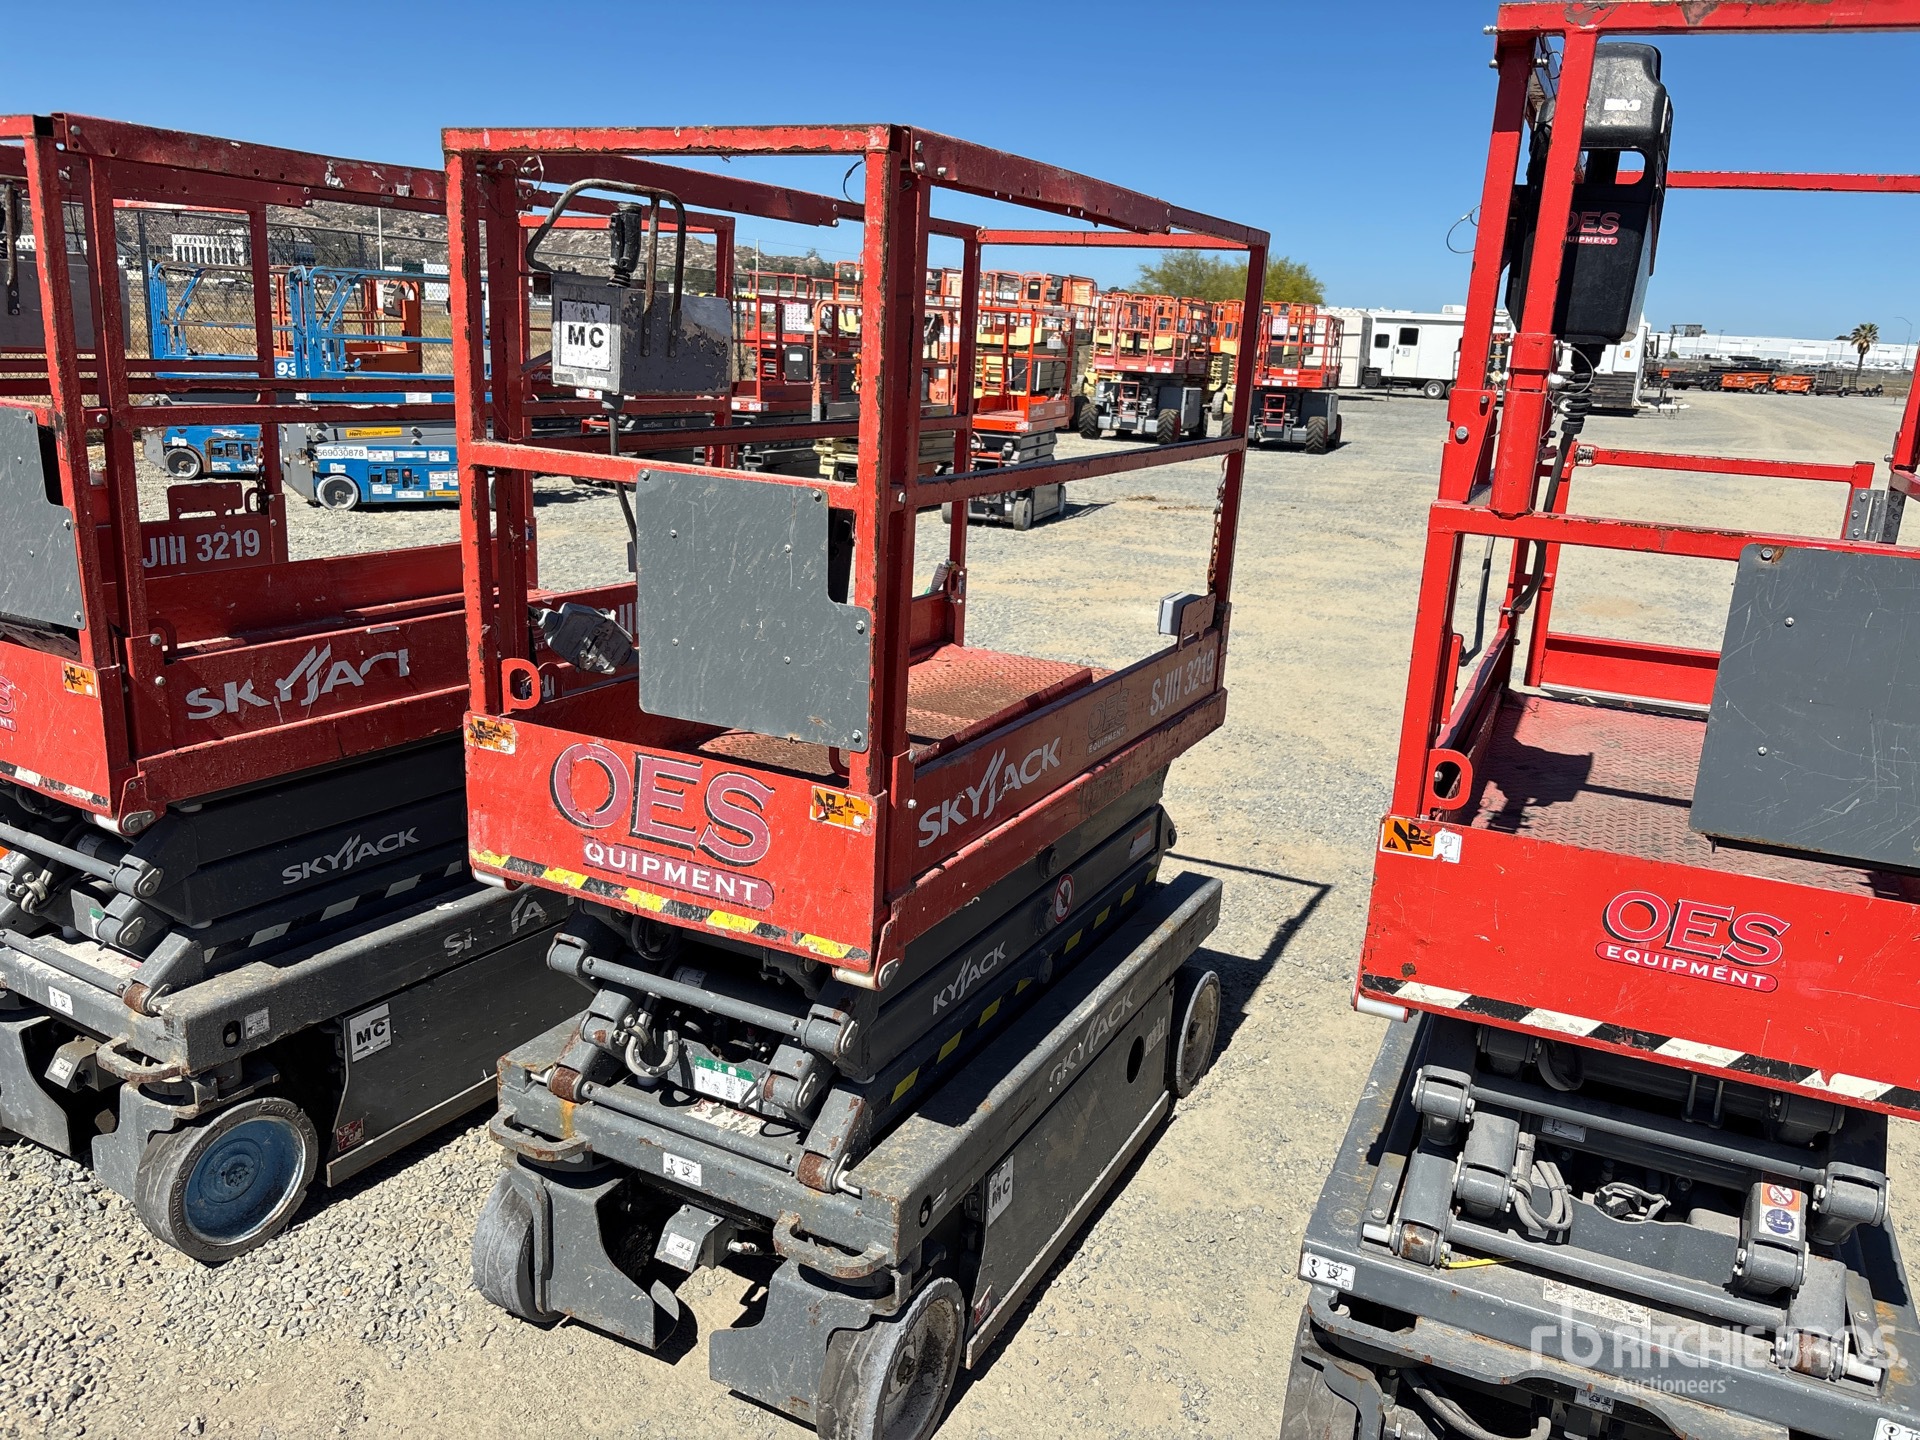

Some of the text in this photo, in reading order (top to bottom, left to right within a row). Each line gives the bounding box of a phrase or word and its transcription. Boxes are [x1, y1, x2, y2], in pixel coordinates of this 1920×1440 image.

[1566, 236, 1615, 244] UIPMENT
[567, 325, 605, 348] MC
[317, 449, 365, 457] 569030878
[196, 529, 260, 562] 3219
[1184, 648, 1215, 696] 3219
[550, 743, 775, 867] OES
[918, 736, 1061, 848] SKYJACK
[281, 827, 420, 885] SKYJACK
[1602, 890, 1791, 966] OES
[1606, 945, 1767, 988] EQUIPMENT
[355, 1022, 386, 1046] MC
[991, 1176, 1011, 1208] MC
